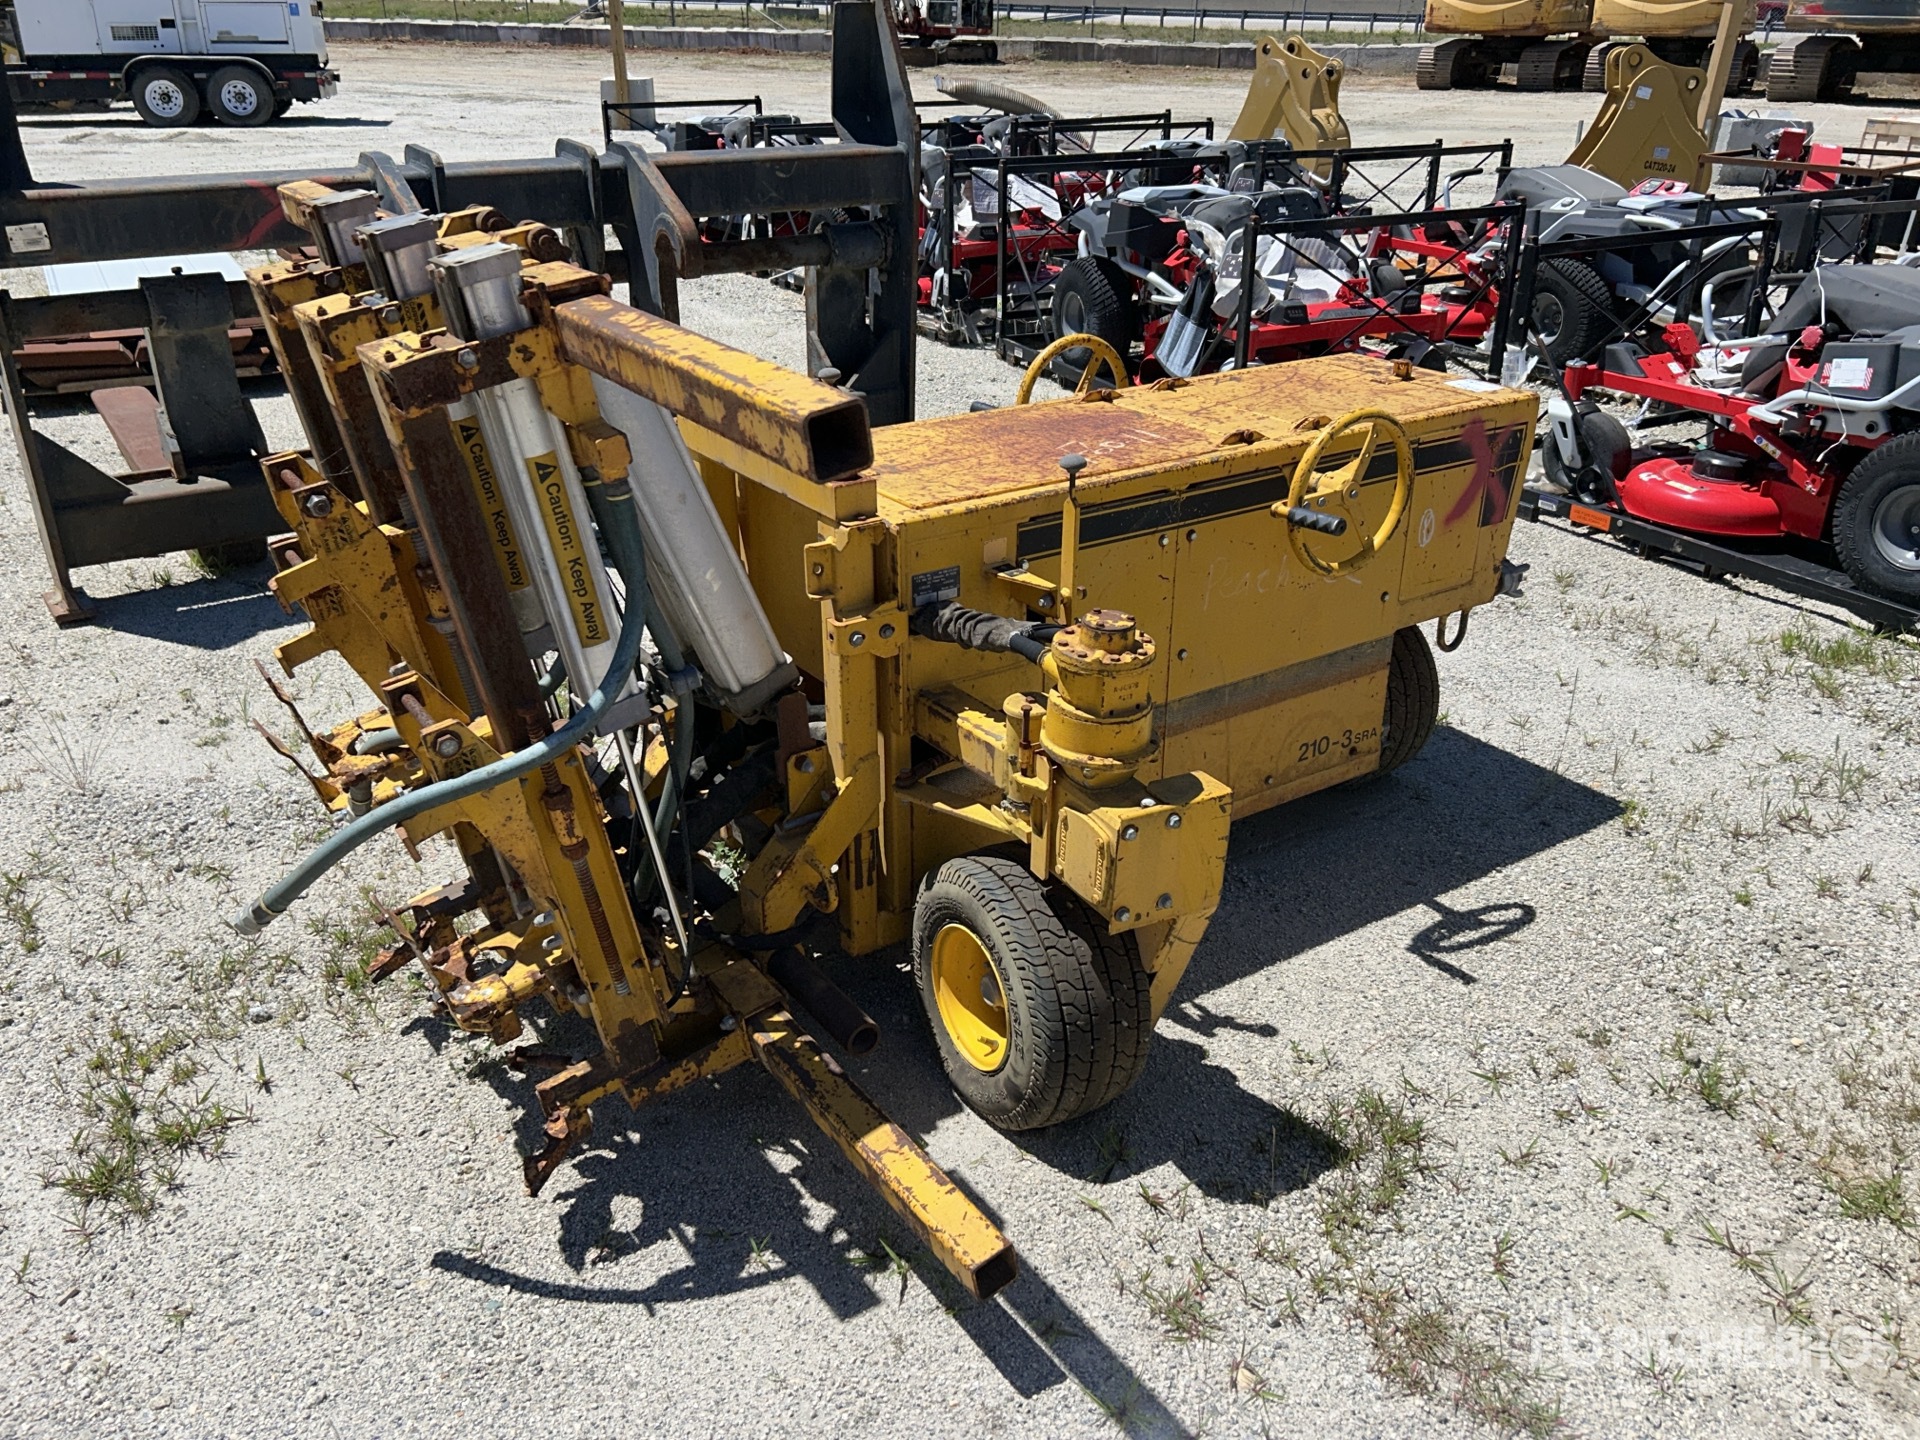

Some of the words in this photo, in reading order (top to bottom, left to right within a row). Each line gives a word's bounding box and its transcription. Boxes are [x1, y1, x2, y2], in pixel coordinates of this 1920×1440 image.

[1643, 160, 1677, 173] CAT320-24
[469, 442, 496, 504] Caution:
[491, 509, 511, 547] Keep
[504, 551, 524, 586] Away
[546, 482, 574, 550] Caution:
[567, 556, 588, 598] Keep
[580, 602, 601, 640] Away
